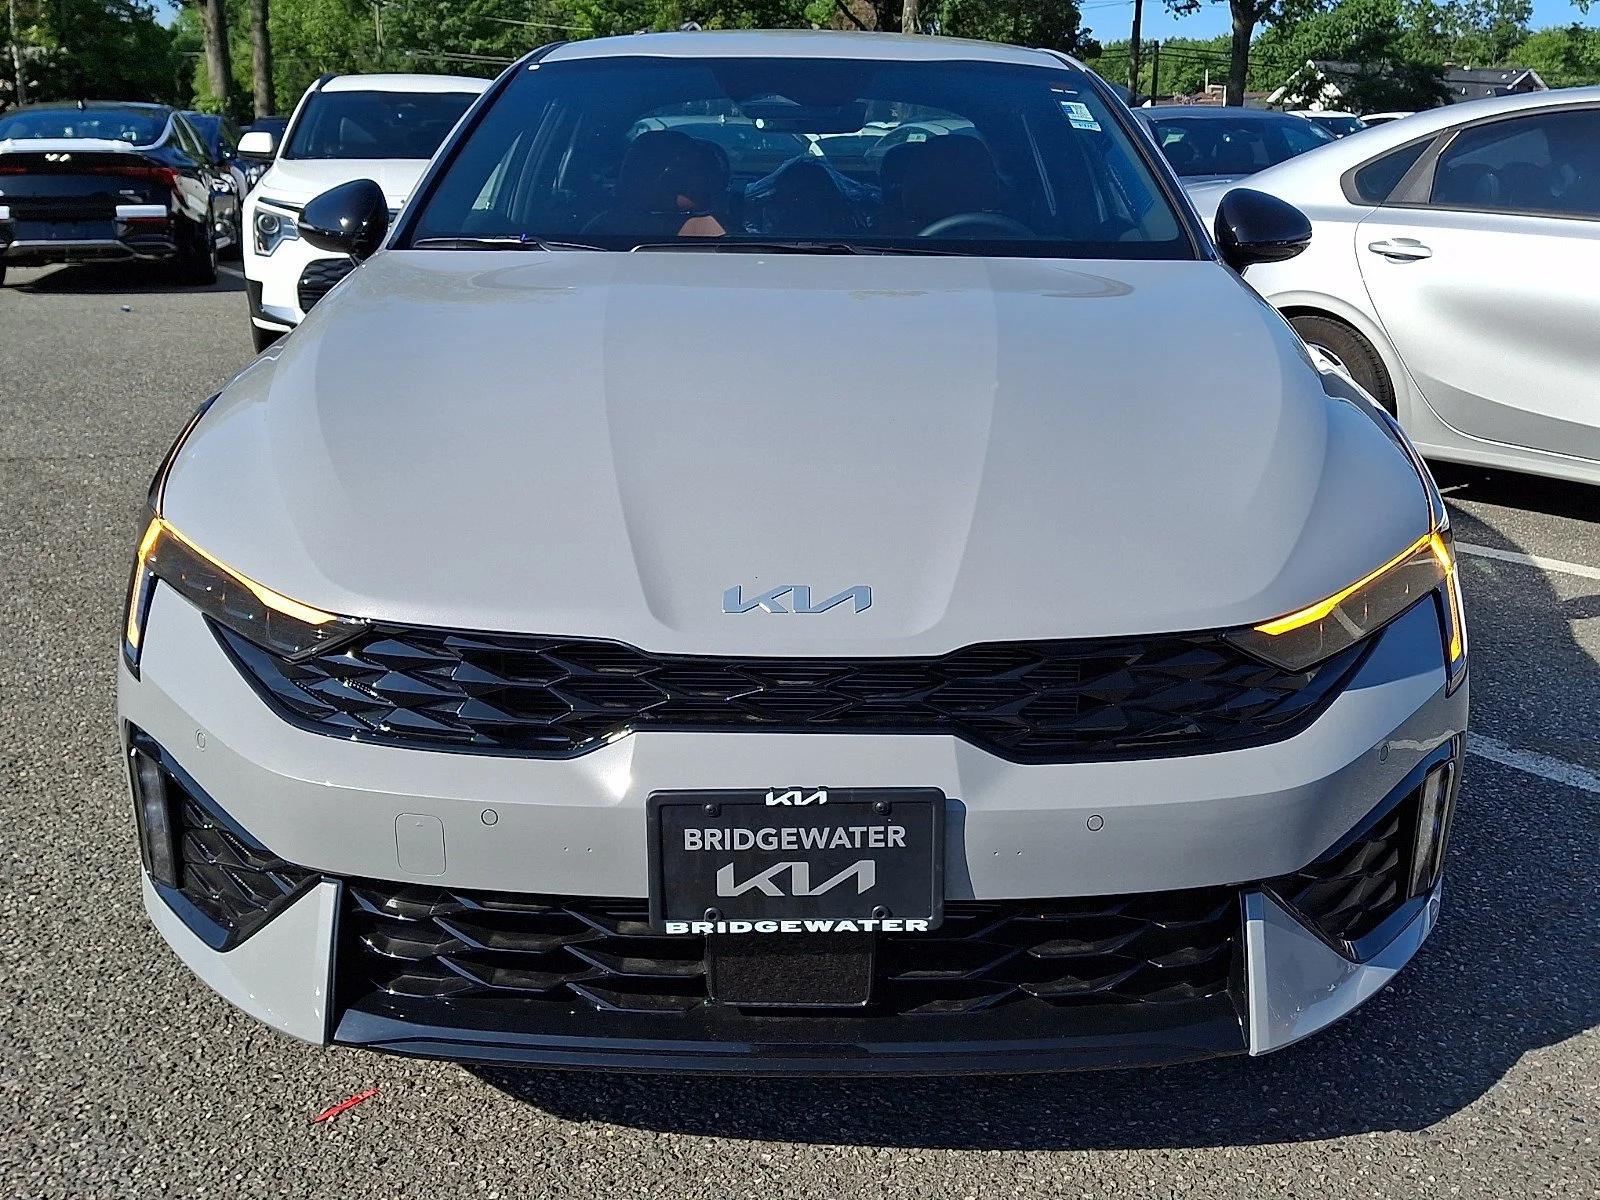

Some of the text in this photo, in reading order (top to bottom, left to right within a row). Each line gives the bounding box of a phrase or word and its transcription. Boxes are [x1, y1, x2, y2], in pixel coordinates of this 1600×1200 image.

[722, 585, 872, 613] KIA
[765, 791, 827, 806] KIA
[684, 826, 907, 850] BRIDGEWATER
[716, 860, 876, 897] KIA
[665, 920, 929, 934] BRIDGEWATER
